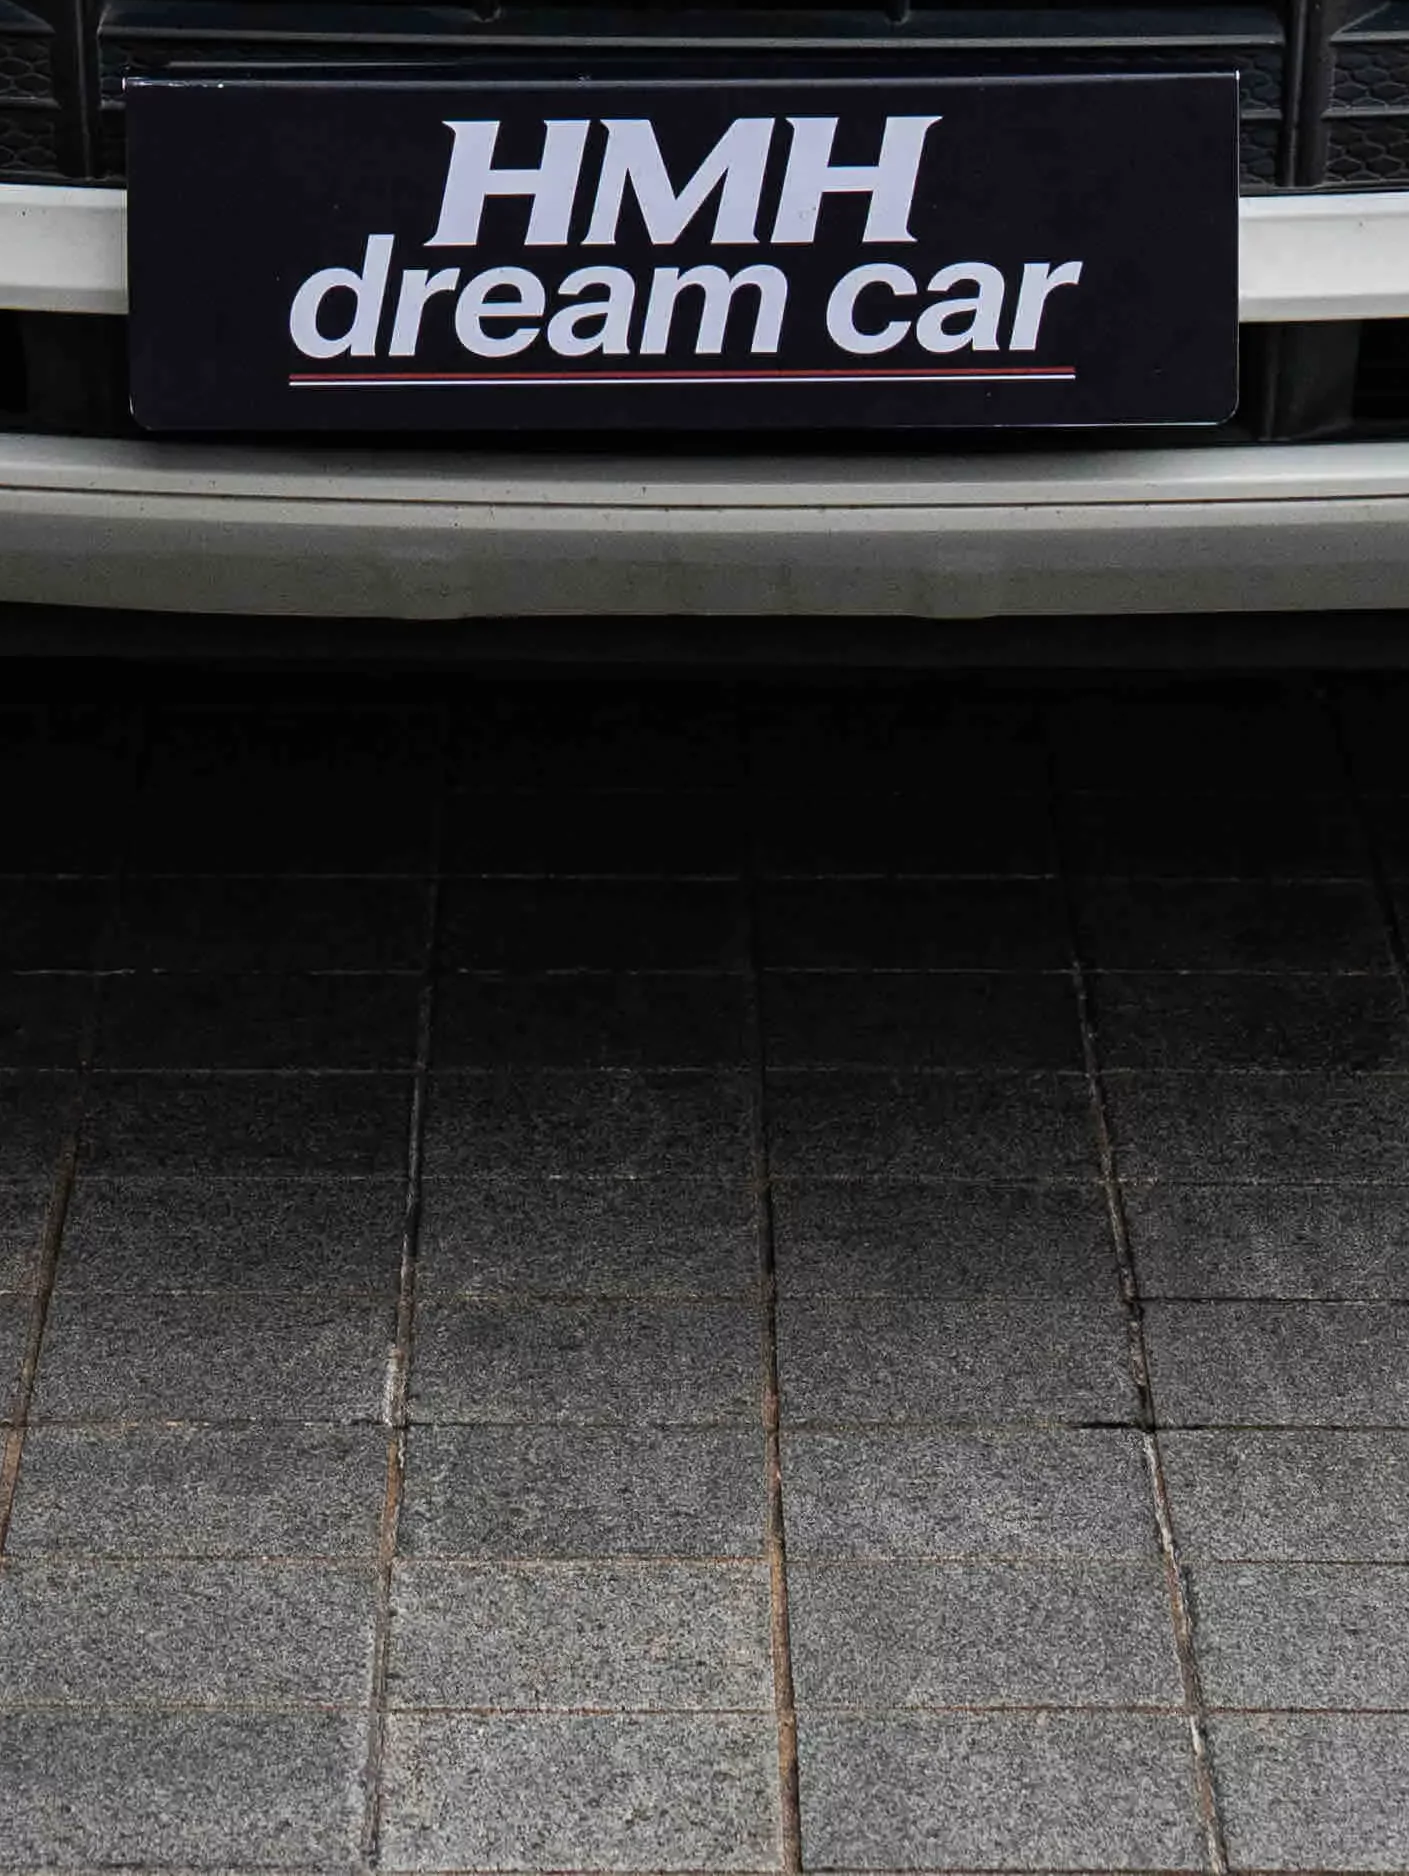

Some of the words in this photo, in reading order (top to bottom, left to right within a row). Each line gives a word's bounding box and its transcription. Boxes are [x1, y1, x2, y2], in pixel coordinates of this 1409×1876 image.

[424, 116, 943, 246] HMH
[289, 233, 788, 358] dream
[826, 260, 1083, 355] car
